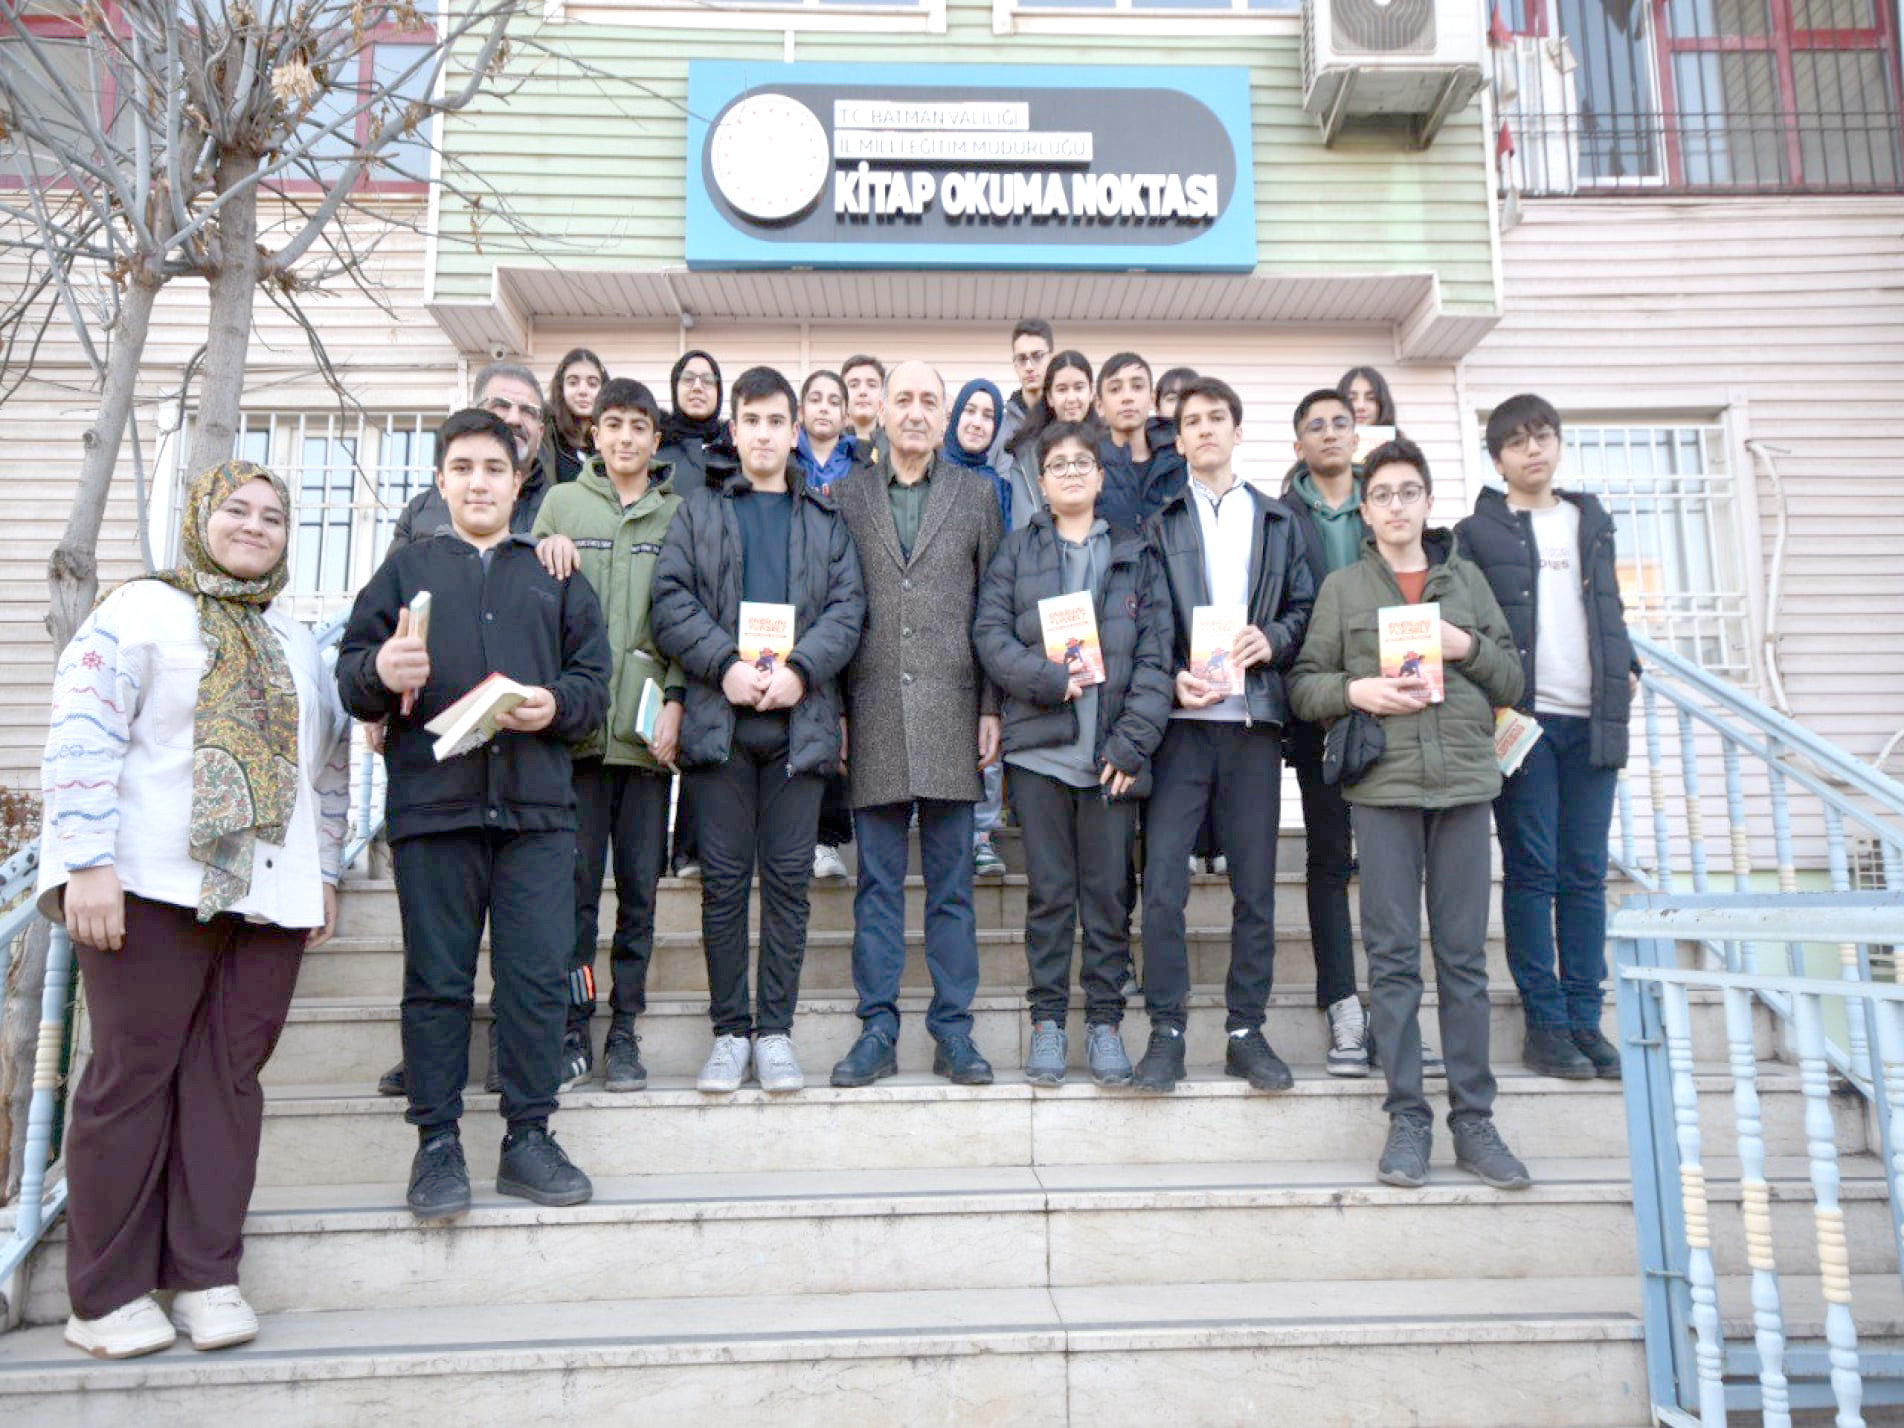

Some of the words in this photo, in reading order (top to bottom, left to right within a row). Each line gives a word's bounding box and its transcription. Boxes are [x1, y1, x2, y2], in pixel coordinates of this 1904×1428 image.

[871, 109, 944, 125] BATMAN
[834, 160, 936, 214] KİTAP
[941, 172, 1069, 217] OKUMA
[1072, 173, 1218, 217] NOKTASI
